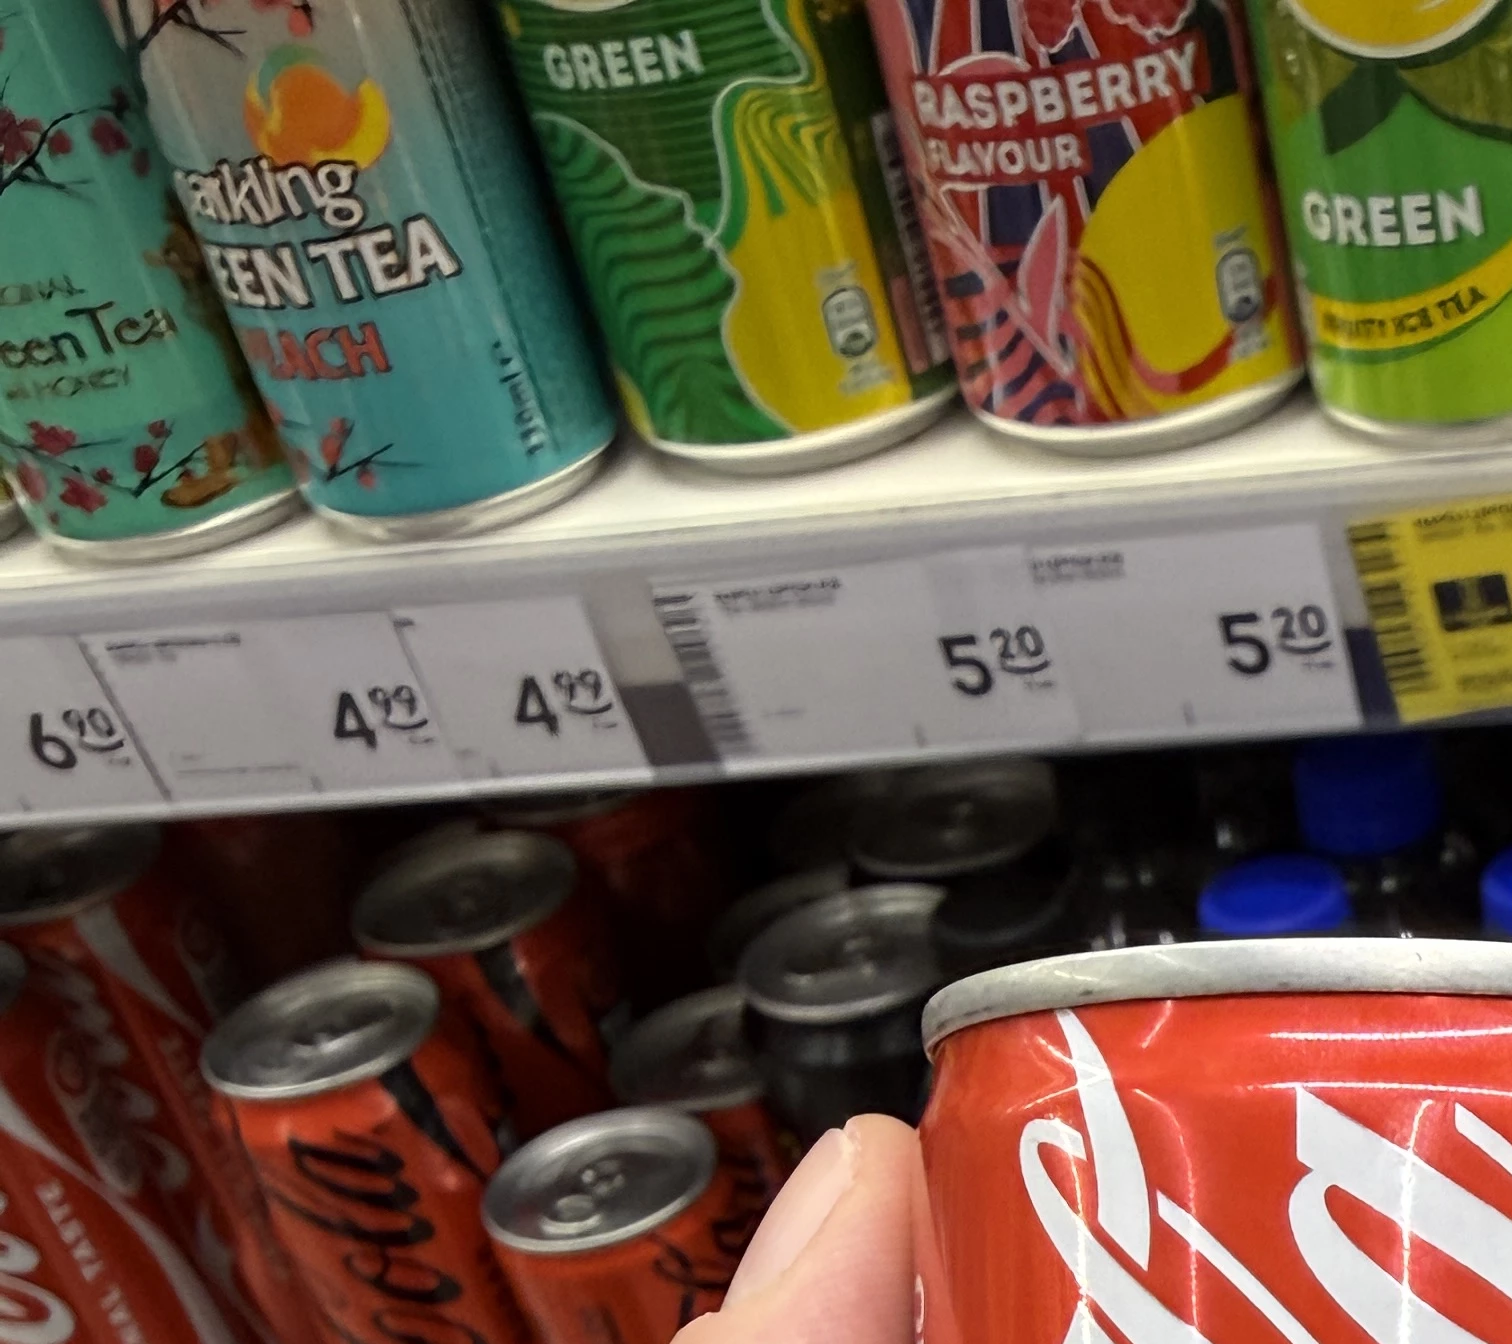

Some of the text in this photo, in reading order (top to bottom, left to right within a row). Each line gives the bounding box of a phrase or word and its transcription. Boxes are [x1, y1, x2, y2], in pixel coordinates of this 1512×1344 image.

[544, 30, 700, 91] GREEN
[912, 40, 1199, 129] RASPBERRY
[926, 133, 1083, 176] FLAVOUR
[1302, 184, 1485, 247] GREEN
[302, 213, 462, 301] TEA
